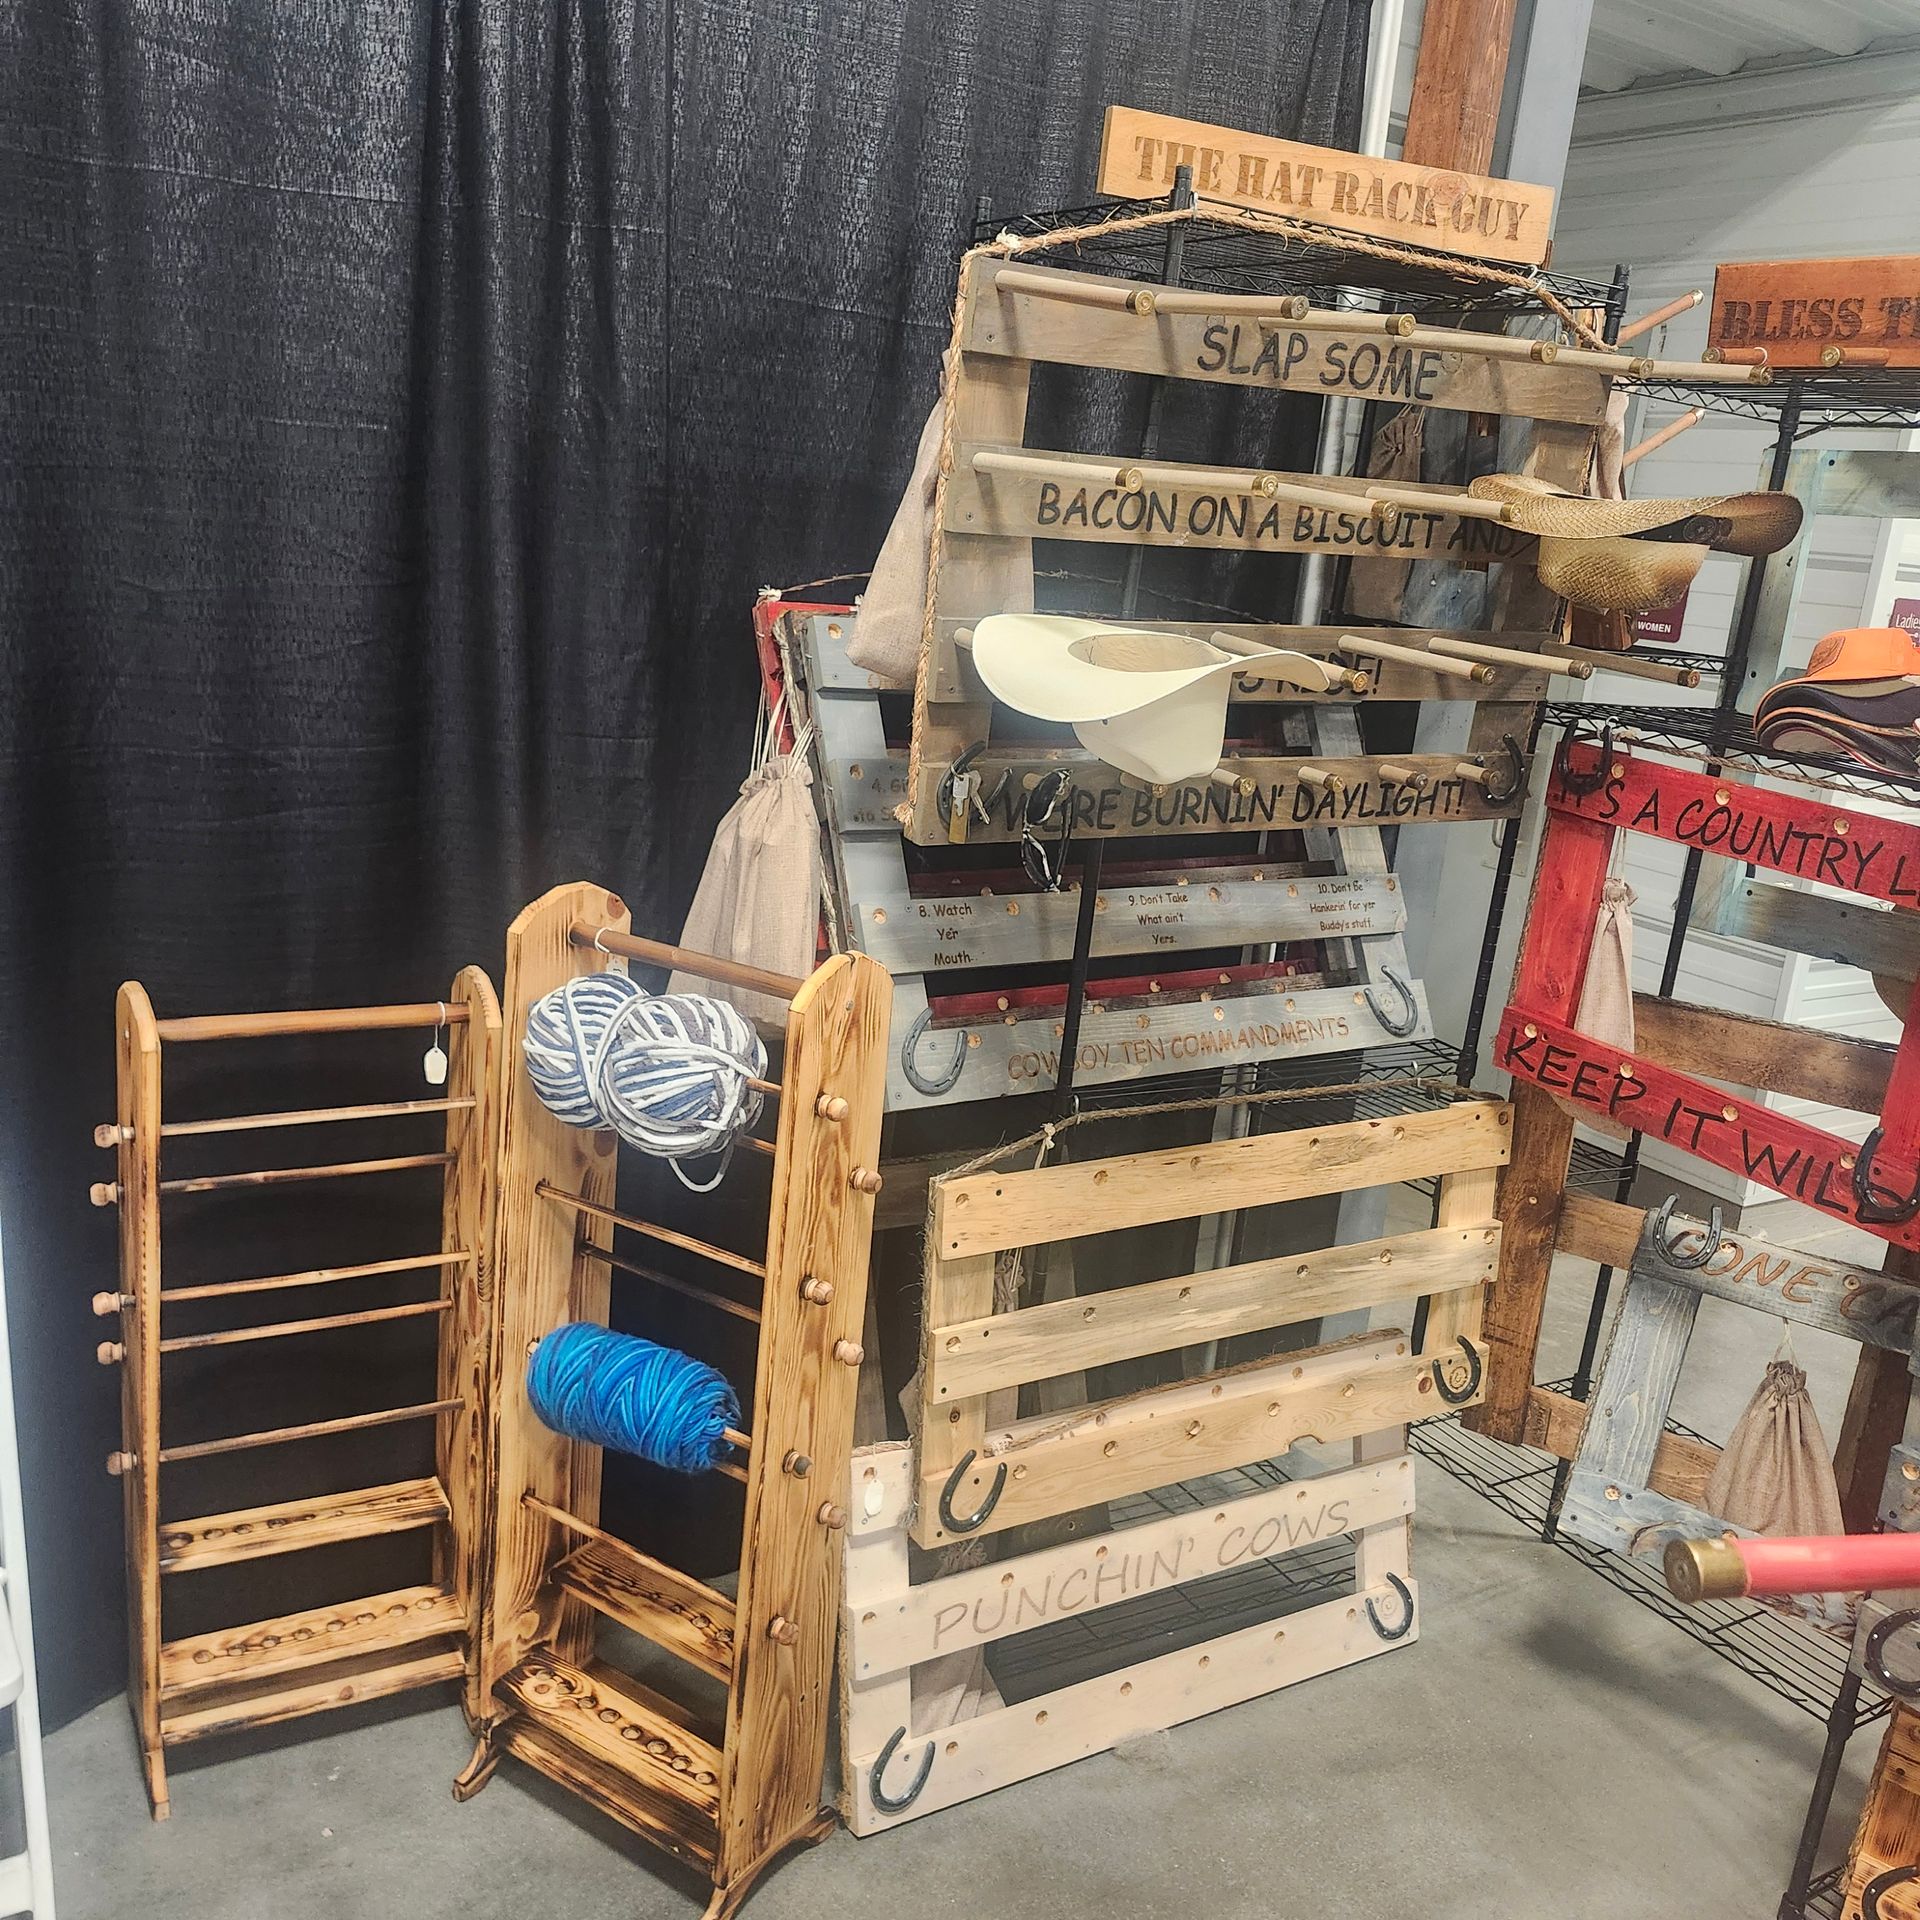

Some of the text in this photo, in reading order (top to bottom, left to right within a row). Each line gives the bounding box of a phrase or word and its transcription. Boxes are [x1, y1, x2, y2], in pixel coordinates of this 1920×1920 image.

[1134, 135, 1530, 242] THE HAT RACK GUY
[1720, 298, 1865, 341] BLESS
[1197, 324, 1444, 401] SLAP SOME
[1037, 482, 1178, 532] BACON
[1188, 496, 1248, 539] ON
[1258, 502, 1281, 542] A
[1293, 505, 1444, 549] BISCUIT
[1637, 621, 1672, 633] WOMEN
[1130, 783, 1284, 827] BURNIN'
[1291, 779, 1464, 823] DAYLIGHT!
[1631, 787, 1659, 832] A
[1675, 798, 1885, 890] COUNTRY
[1889, 855, 1920, 907] L
[919, 902, 973, 917] 8. Watch
[1128, 892, 1189, 906] 9. Don't Take
[1317, 882, 1330, 894] 10.
[1348, 900, 1361, 911] for
[1136, 911, 1184, 925] What ain't
[1151, 933, 1178, 945] Yers.
[1007, 1016, 1350, 1080] COWOY TEN COMMANDMENTS
[1504, 1027, 1648, 1116] KEEP
[1663, 1098, 1727, 1150] IT
[1667, 1229, 1833, 1304] GONE
[933, 1500, 1351, 1650] PUNCHIN' COWS
